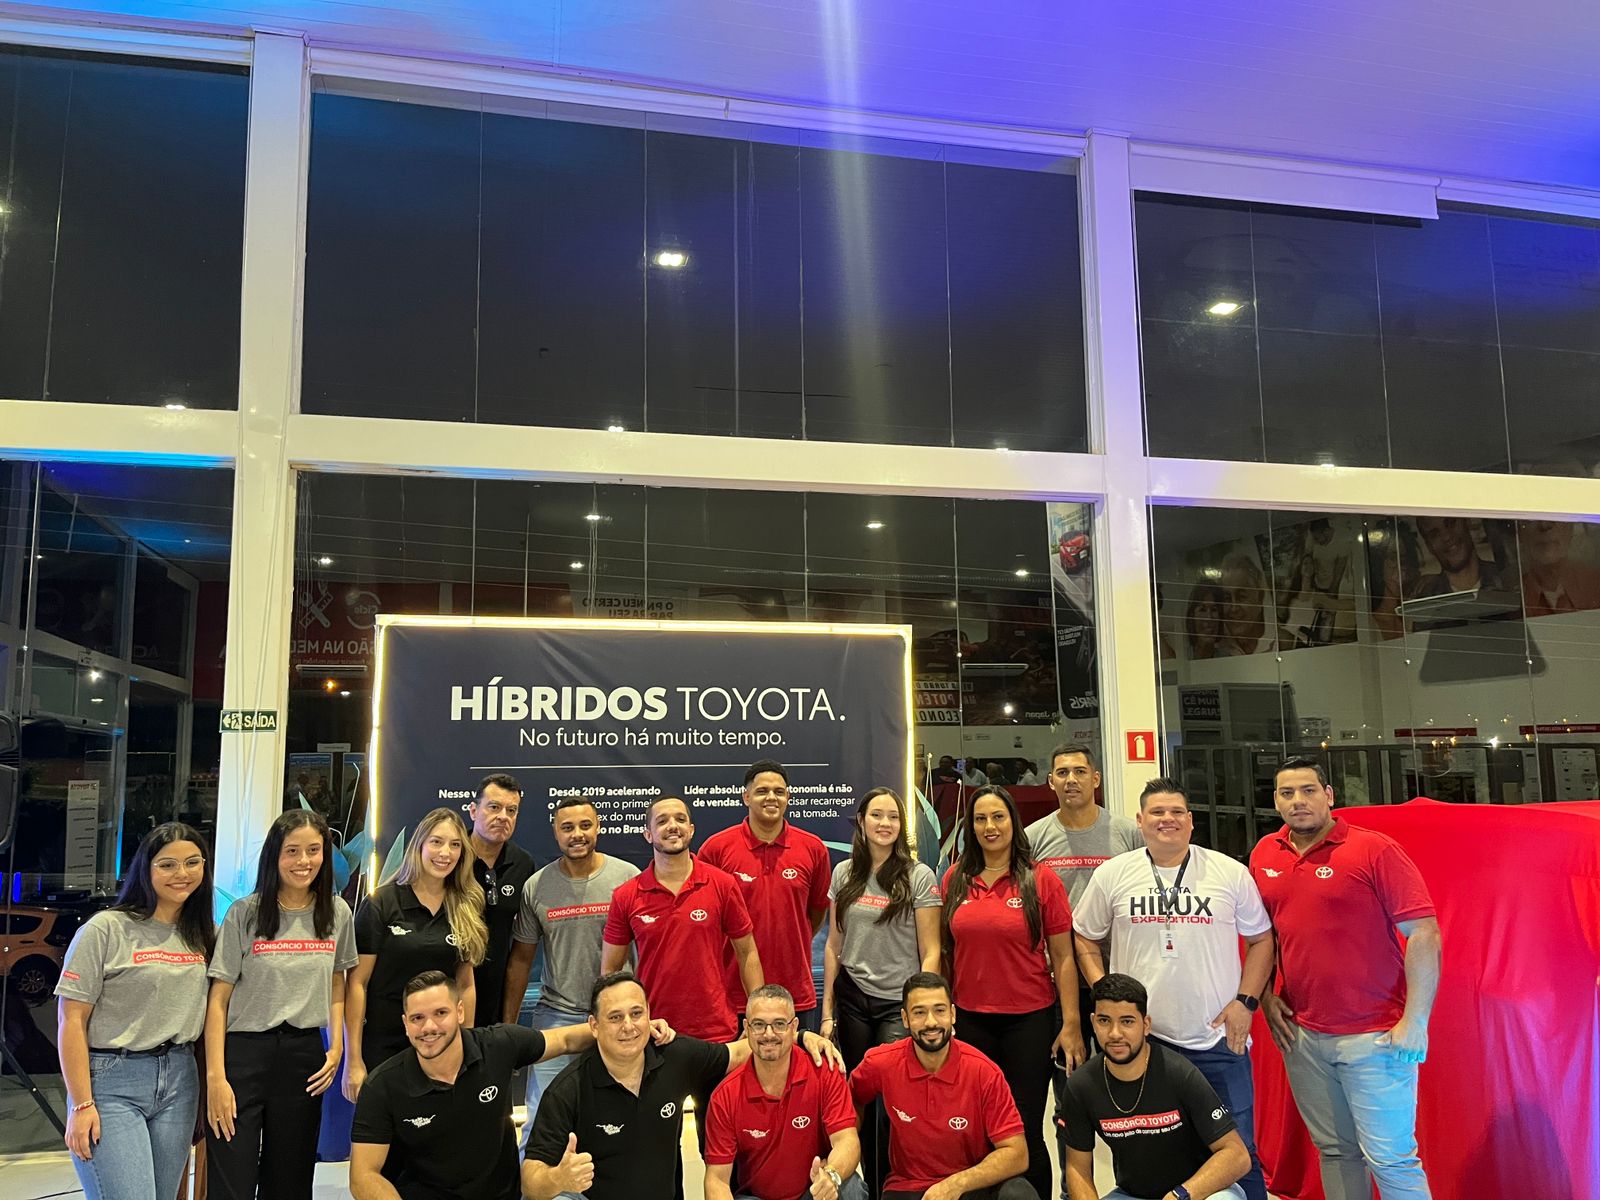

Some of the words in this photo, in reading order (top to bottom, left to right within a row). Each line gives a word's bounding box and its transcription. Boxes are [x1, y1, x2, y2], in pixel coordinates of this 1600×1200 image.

[450, 676, 668, 721] HÍBRIDOS
[676, 687, 846, 721] TOYOTA.
[243, 712, 276, 728] SAÍDA
[519, 728, 550, 746] No
[556, 727, 618, 746] futuro
[624, 727, 649, 746] há
[655, 728, 713, 746] muito
[718, 728, 786, 750] tempo.
[549, 787, 581, 797] Desde
[582, 787, 606, 796] 2019
[606, 786, 661, 796] acelerando
[684, 785, 709, 795] Líder
[709, 784, 747, 795] absolut
[786, 784, 827, 793] tonomia
[828, 783, 835, 793] é
[835, 783, 853, 793] não
[438, 789, 470, 799] Nesse
[547, 802, 555, 810] o
[612, 801, 620, 809] o
[621, 799, 652, 810] primei
[692, 797, 706, 807] de
[706, 797, 743, 807] vendas.
[788, 796, 808, 806] cisar
[810, 797, 856, 808] recarregar
[609, 812, 623, 822] do
[625, 813, 647, 822] mun
[789, 810, 801, 818] na
[802, 808, 840, 818] tomada.
[608, 825, 622, 834] no
[623, 824, 647, 834] Brasi
[1044, 857, 1083, 866] CONSÓRCIO
[547, 906, 588, 918] CONSÓRCIO
[588, 904, 610, 913] TOYOT
[1129, 895, 1213, 917] HILUX
[254, 941, 303, 951] CONSÓRCIO
[303, 942, 334, 950] TOYOTA
[135, 952, 183, 962] CONSÓRCIO
[183, 953, 205, 962] TOYO
[1101, 1118, 1148, 1130] CONSÓRCIO
[1147, 1112, 1180, 1125] TOYOTA
